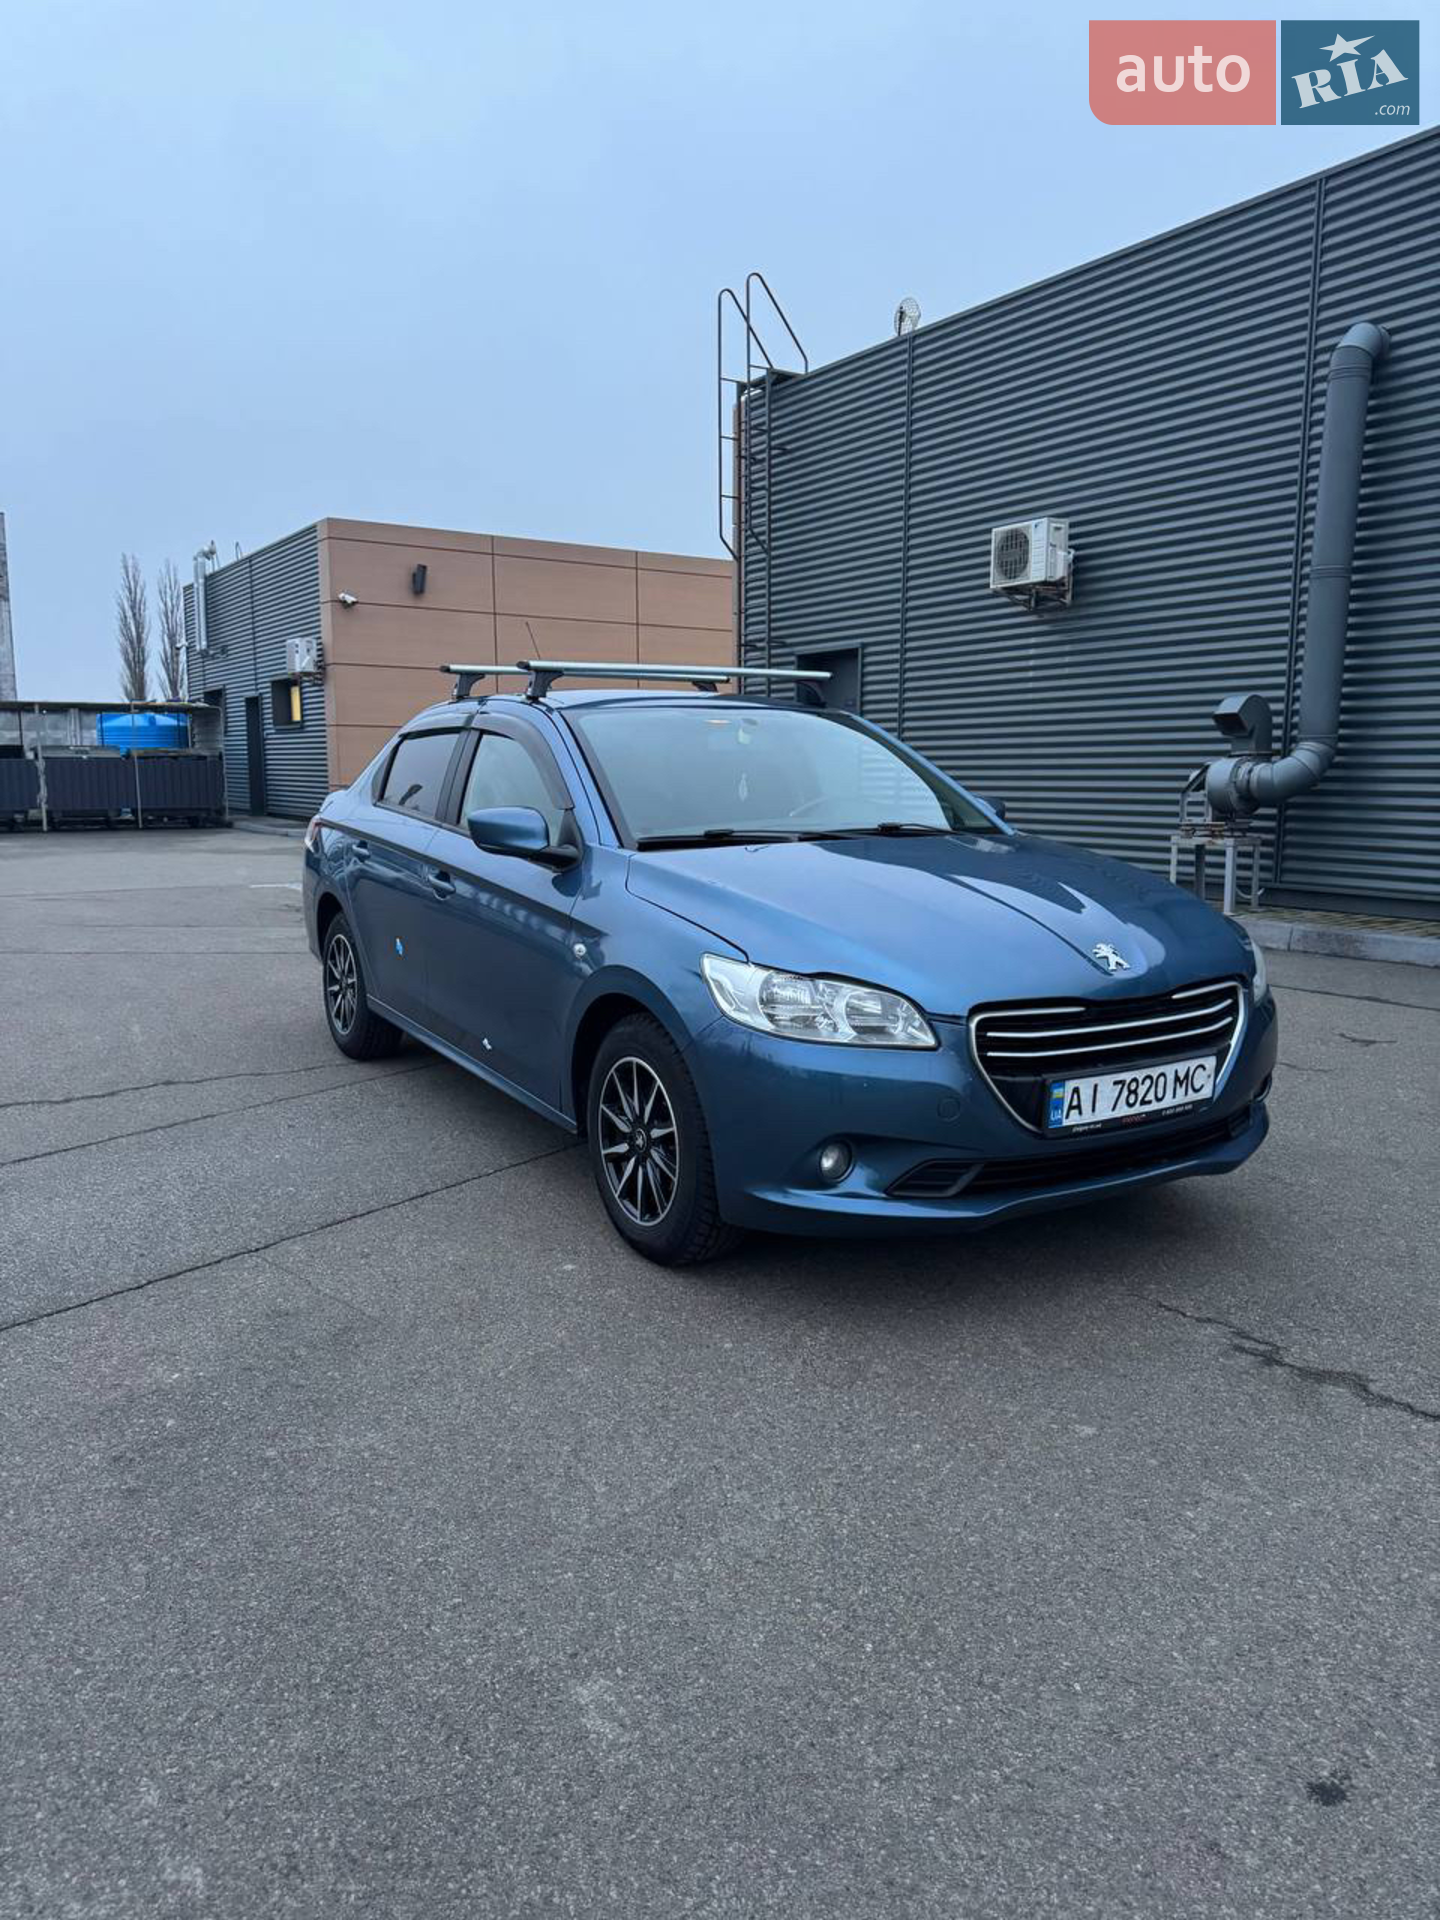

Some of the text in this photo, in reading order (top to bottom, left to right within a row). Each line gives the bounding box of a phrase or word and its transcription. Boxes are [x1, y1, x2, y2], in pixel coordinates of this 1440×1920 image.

[1111, 1072, 1167, 1112] 7820
[1172, 1064, 1207, 1099] MC
[1050, 1108, 1062, 1122] UA
